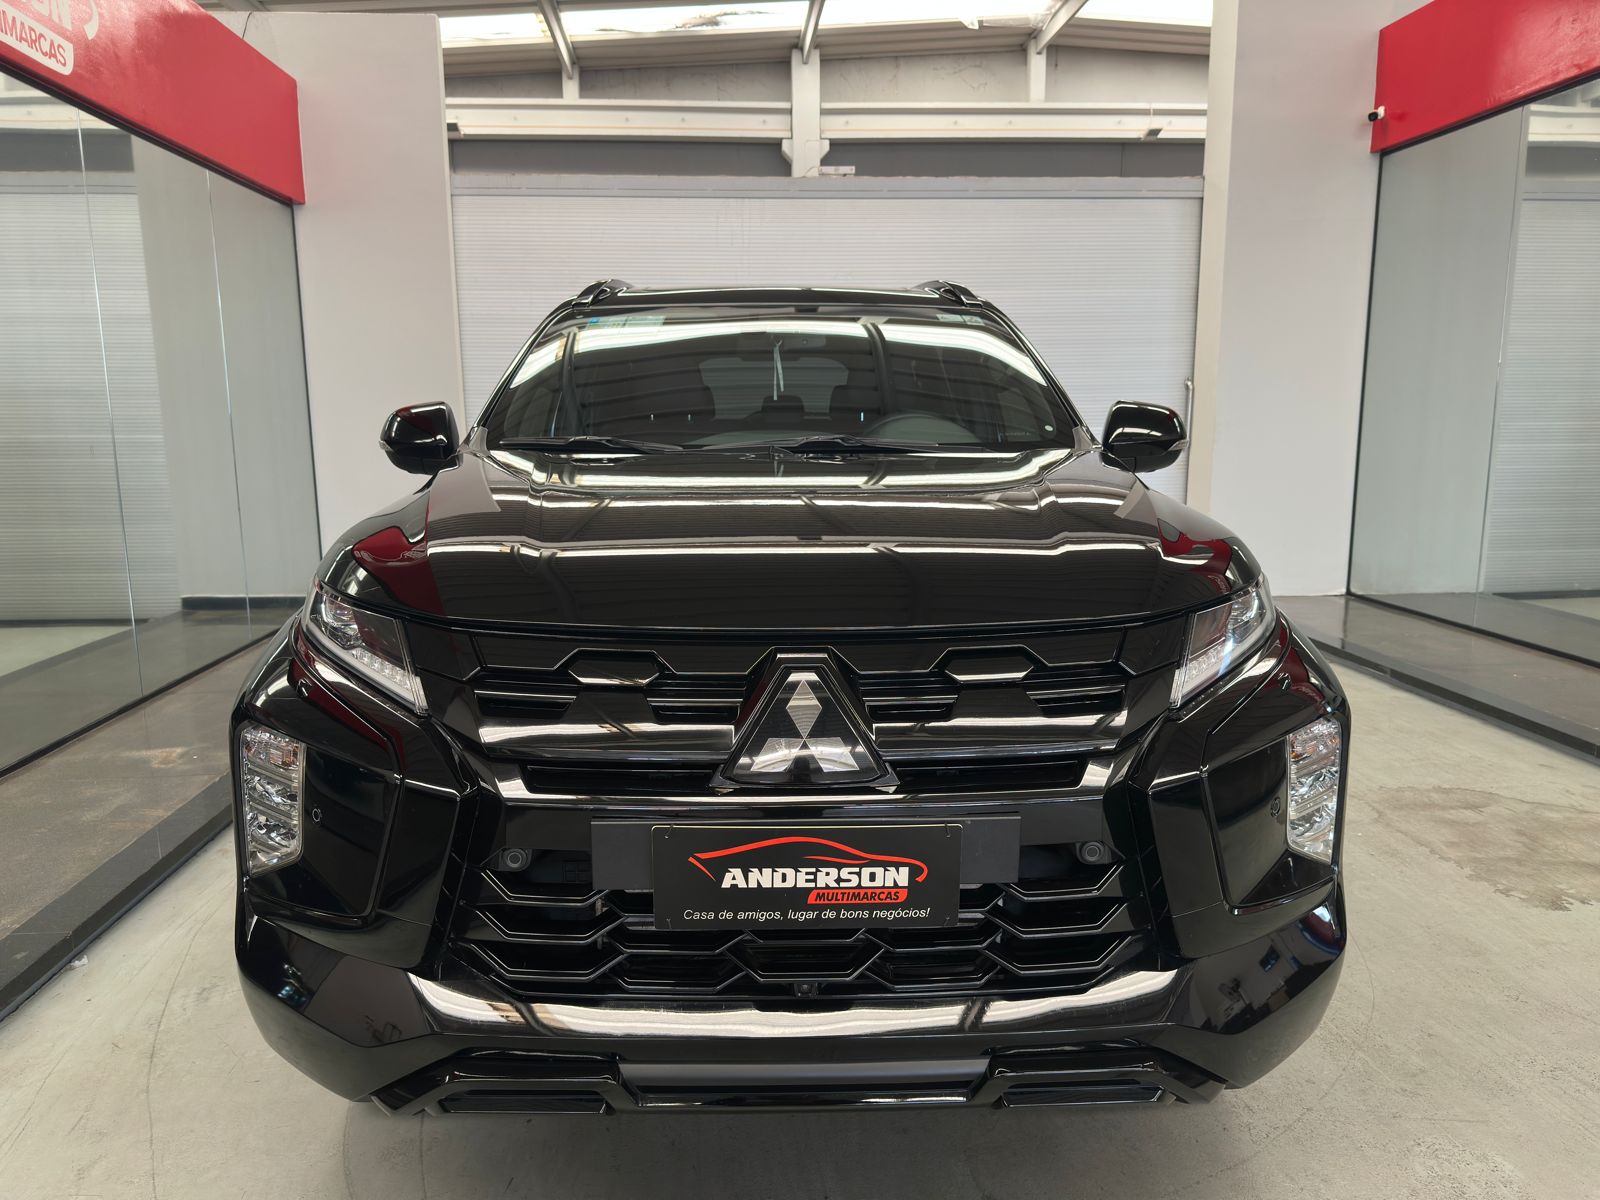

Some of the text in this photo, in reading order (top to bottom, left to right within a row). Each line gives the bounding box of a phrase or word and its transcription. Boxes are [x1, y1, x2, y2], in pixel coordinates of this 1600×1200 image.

[721, 866, 909, 888] ANDERSON
[814, 891, 901, 902] MULTIMARCAS
[683, 907, 930, 922] Casa de amigos, lugar de bons negócios!
